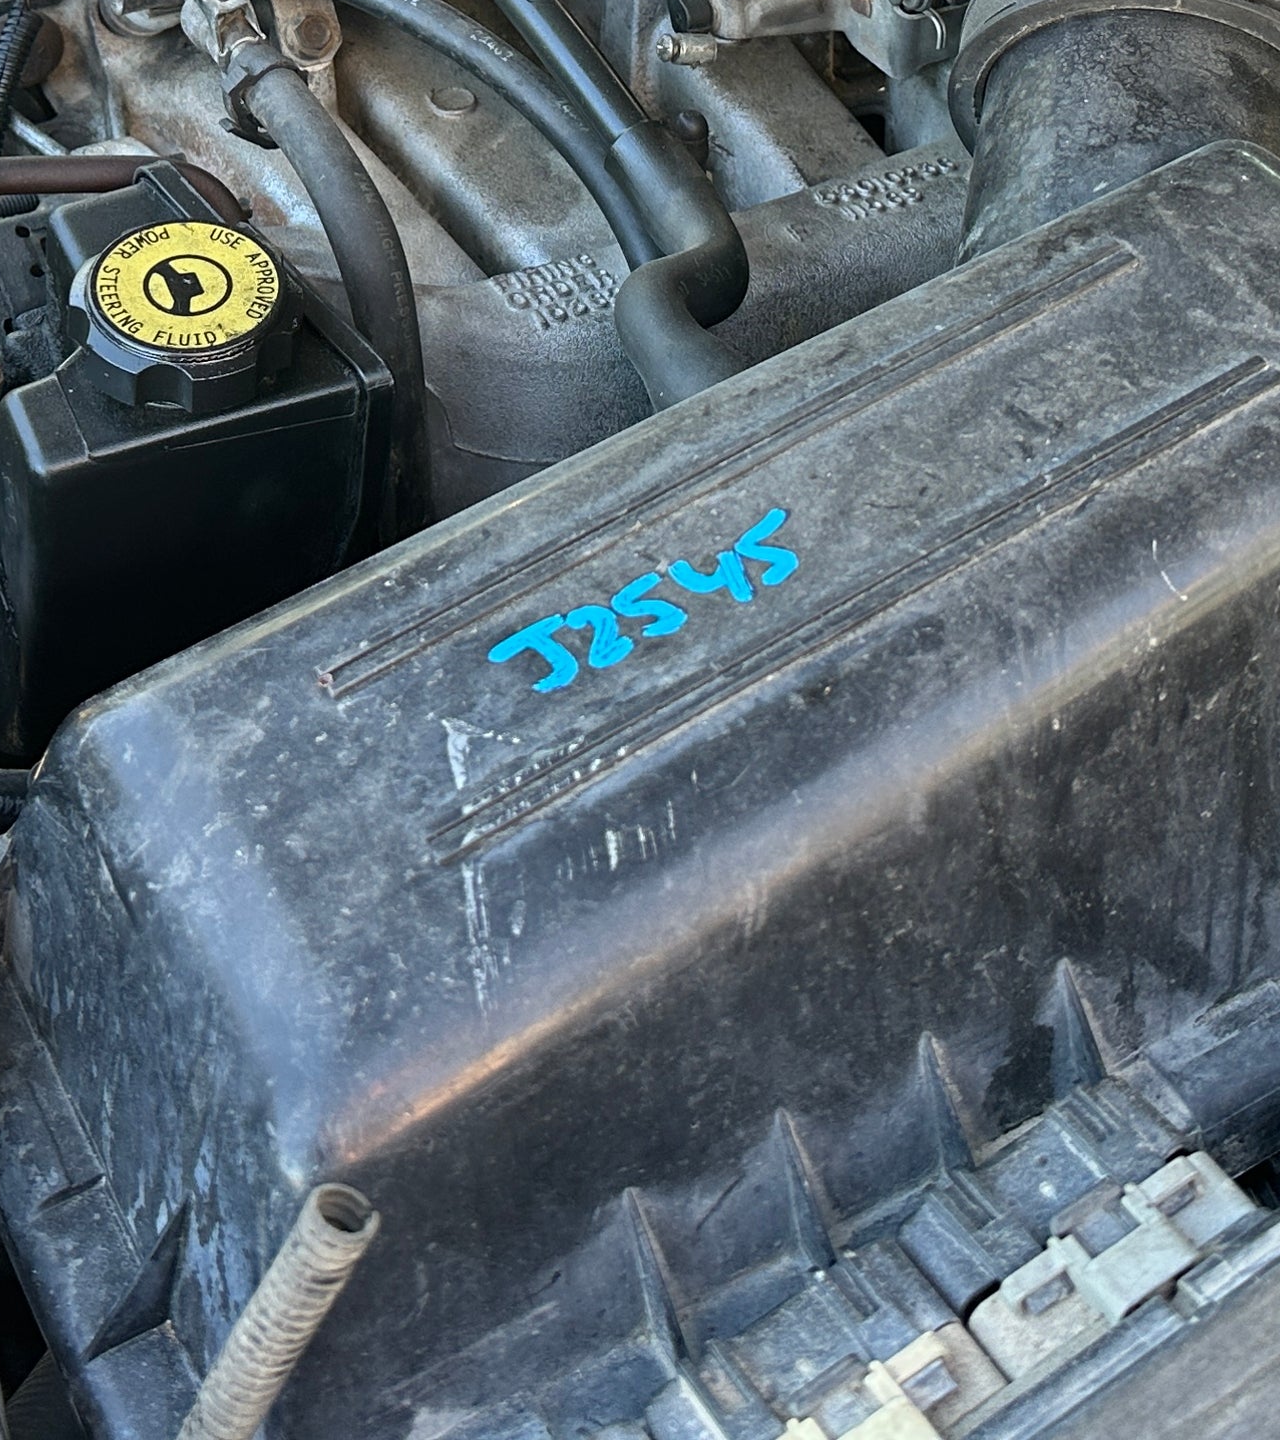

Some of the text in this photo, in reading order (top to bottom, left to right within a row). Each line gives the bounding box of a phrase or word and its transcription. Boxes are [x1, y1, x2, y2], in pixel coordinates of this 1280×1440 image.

[99, 227, 217, 347] POWER STEERING FLUID
[209, 227, 276, 320] USE APPROVED
